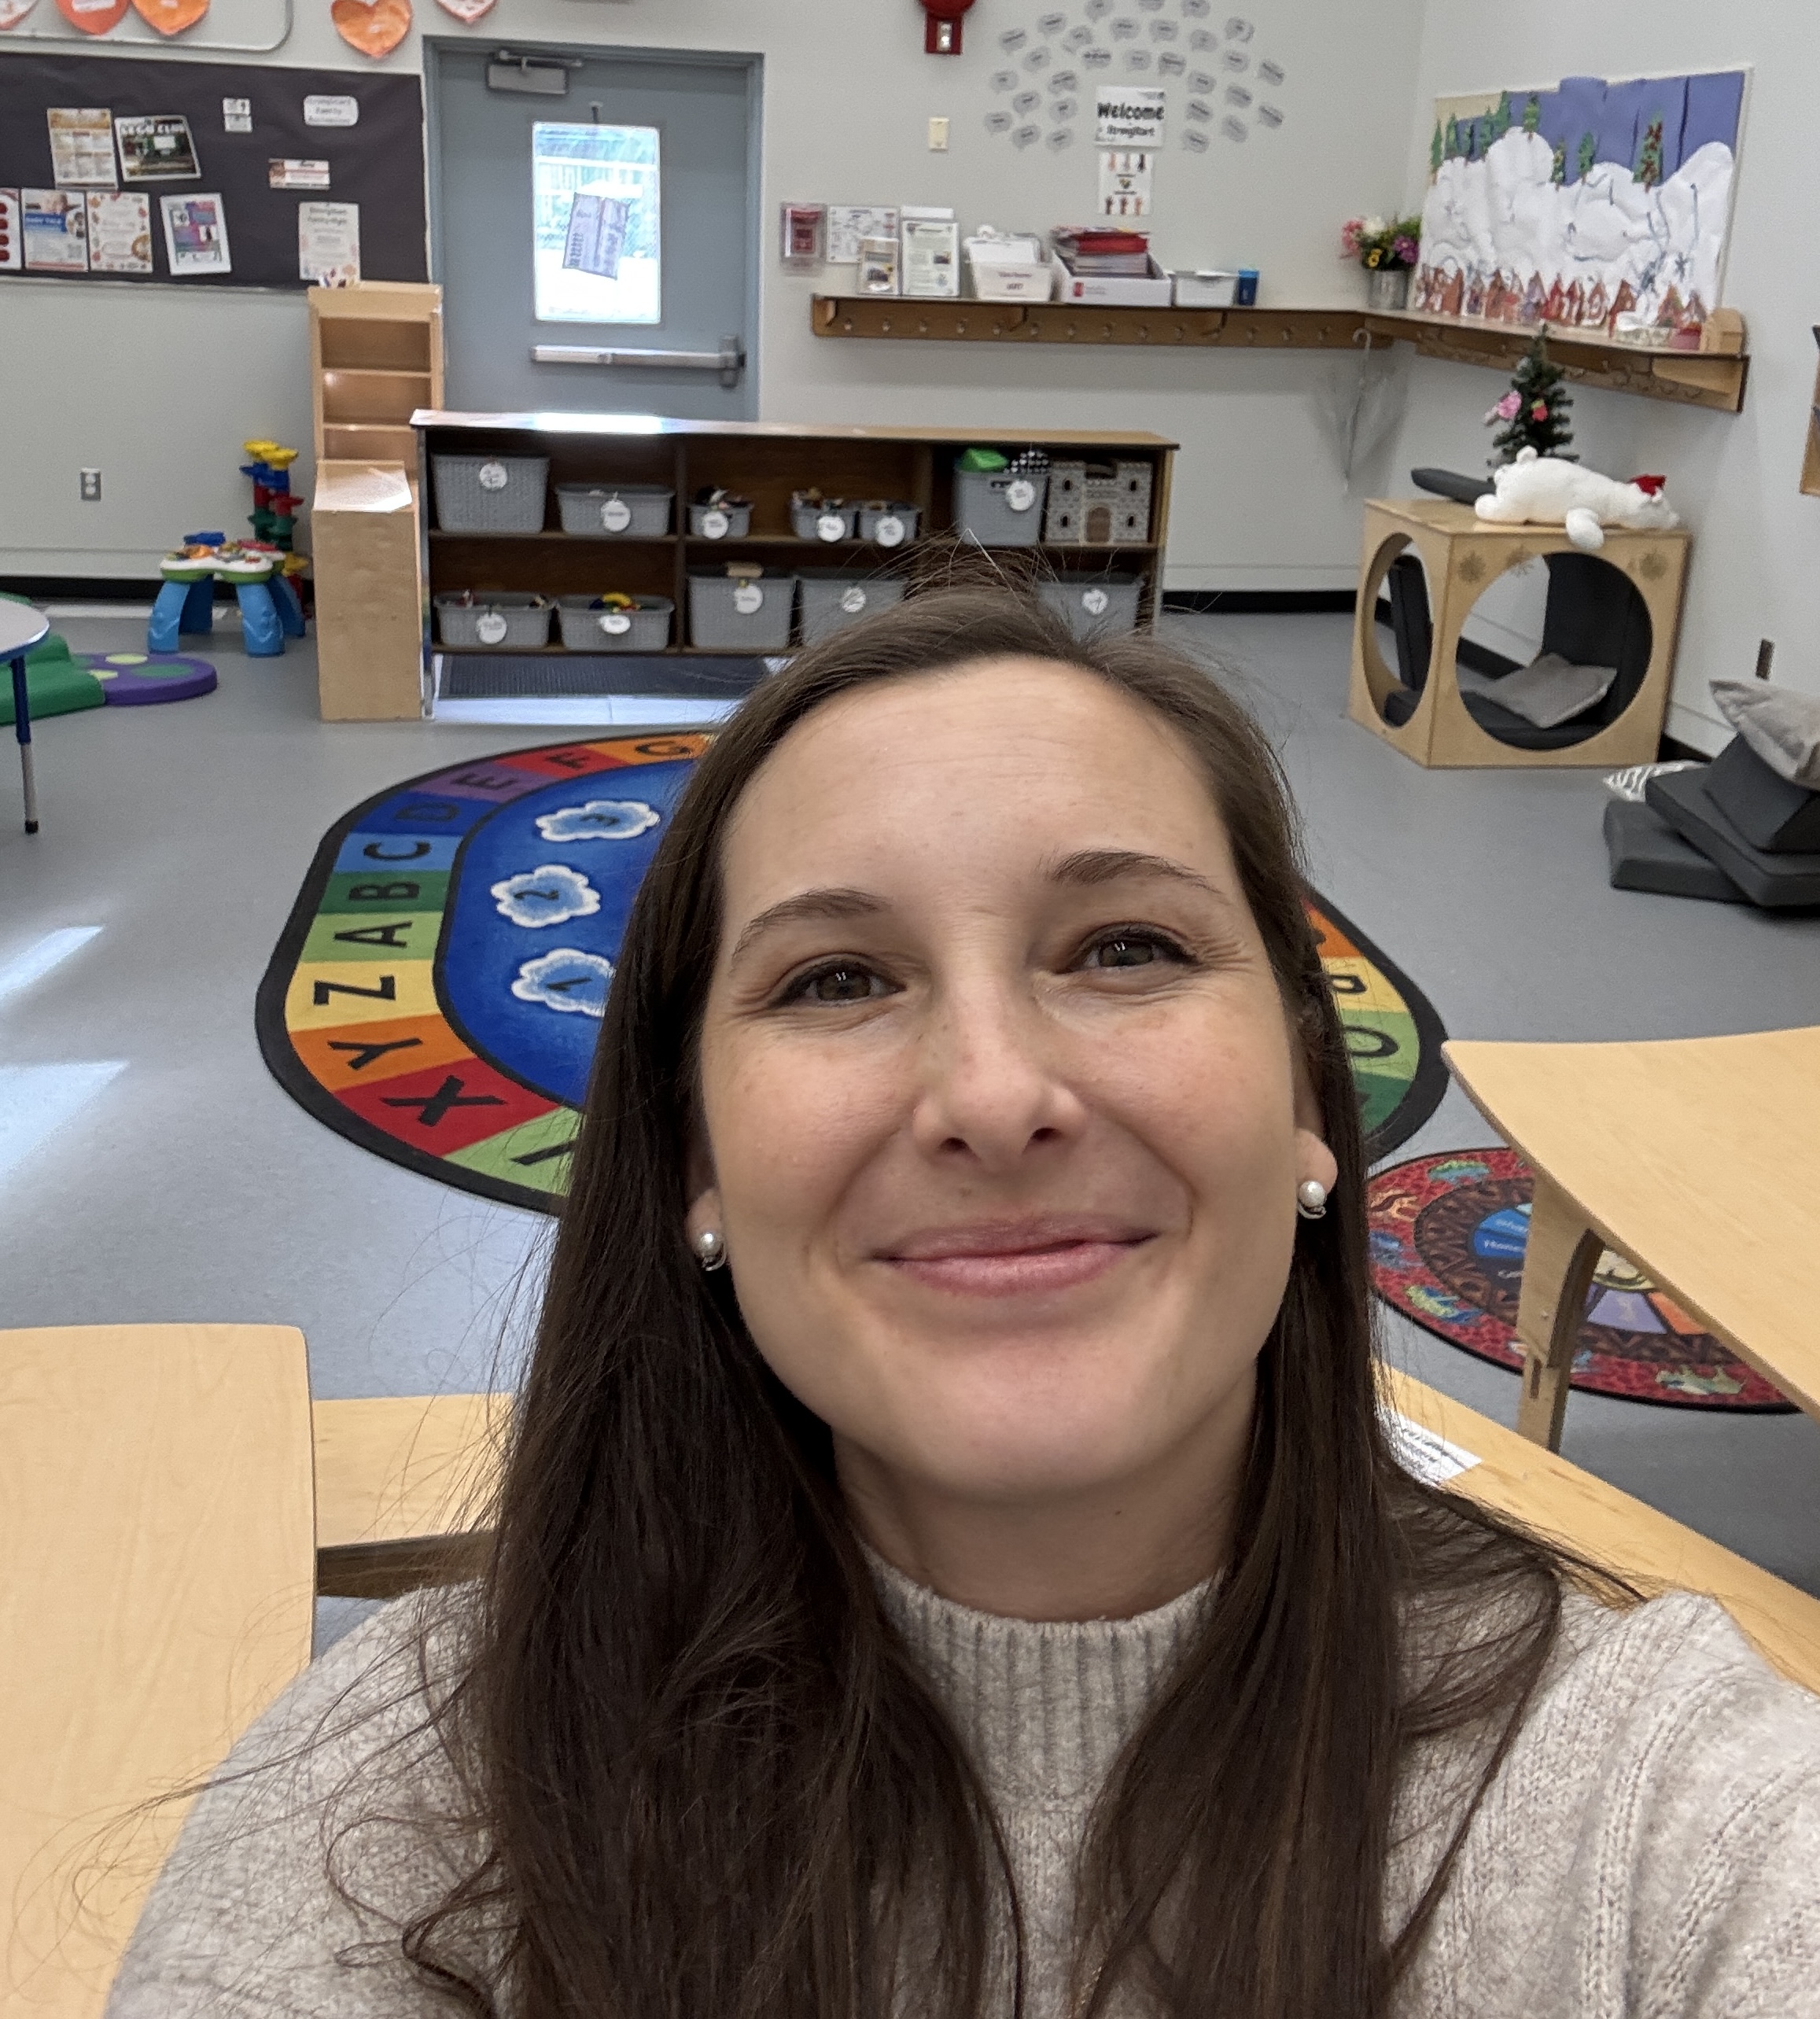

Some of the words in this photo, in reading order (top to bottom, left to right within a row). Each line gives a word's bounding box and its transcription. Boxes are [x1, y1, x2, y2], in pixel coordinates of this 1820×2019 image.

[1097, 102, 1164, 120] Welcome
[635, 740, 691, 756] G
[545, 752, 591, 769] F
[450, 772, 519, 790] E
[395, 801, 460, 822] D
[578, 812, 621, 827] 3
[363, 840, 431, 861] C
[348, 882, 420, 901] B
[514, 890, 559, 901] 2
[333, 920, 413, 949] A
[314, 974, 396, 1005] Z
[546, 977, 592, 992] 1
[327, 1037, 423, 1070] Y
[379, 1074, 507, 1127] X
